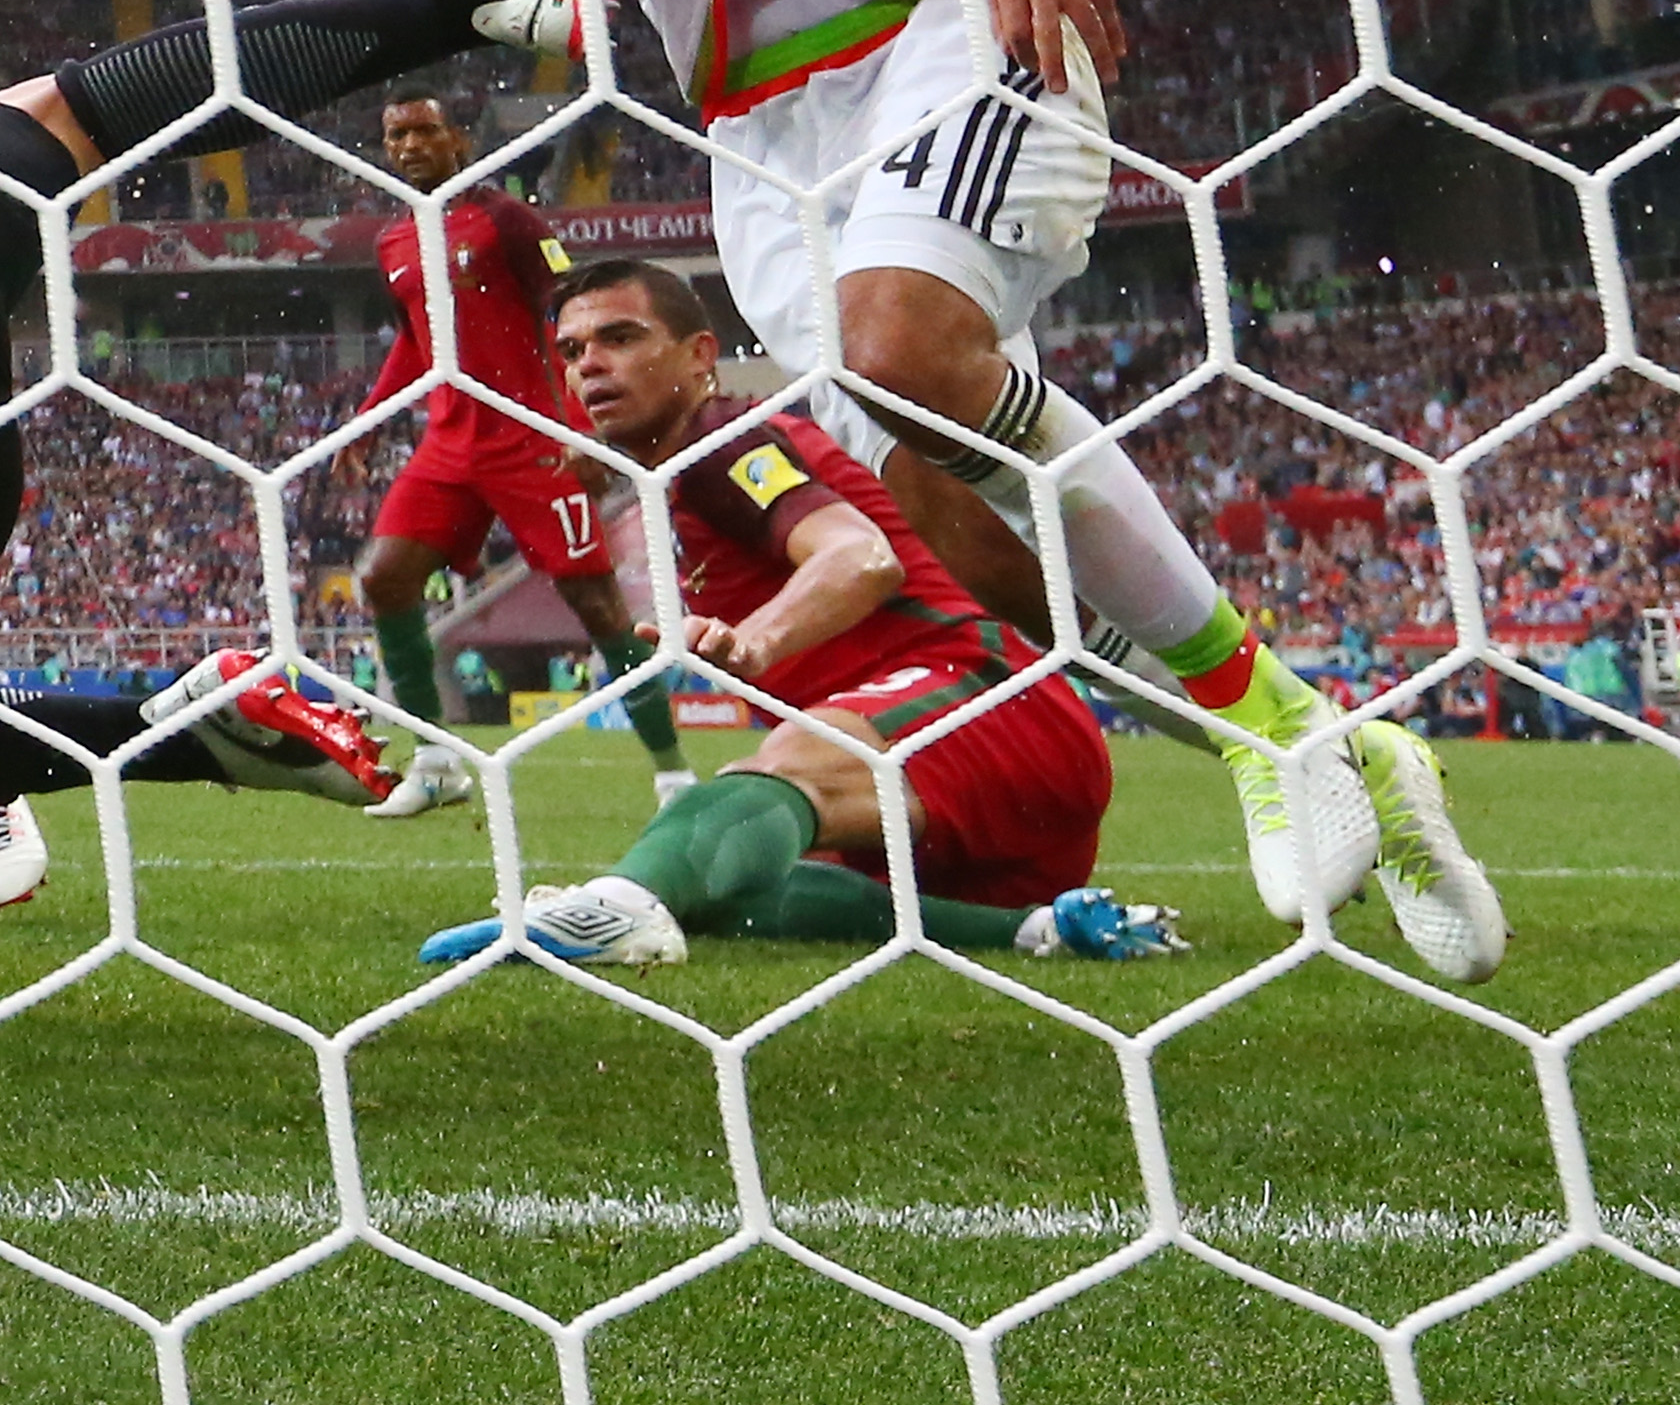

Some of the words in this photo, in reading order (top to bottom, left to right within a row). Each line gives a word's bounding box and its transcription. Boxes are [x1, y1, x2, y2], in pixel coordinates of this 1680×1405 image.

[881, 109, 938, 188] 4
[619, 213, 714, 240] ЧЕМП
[551, 492, 591, 546] 17
